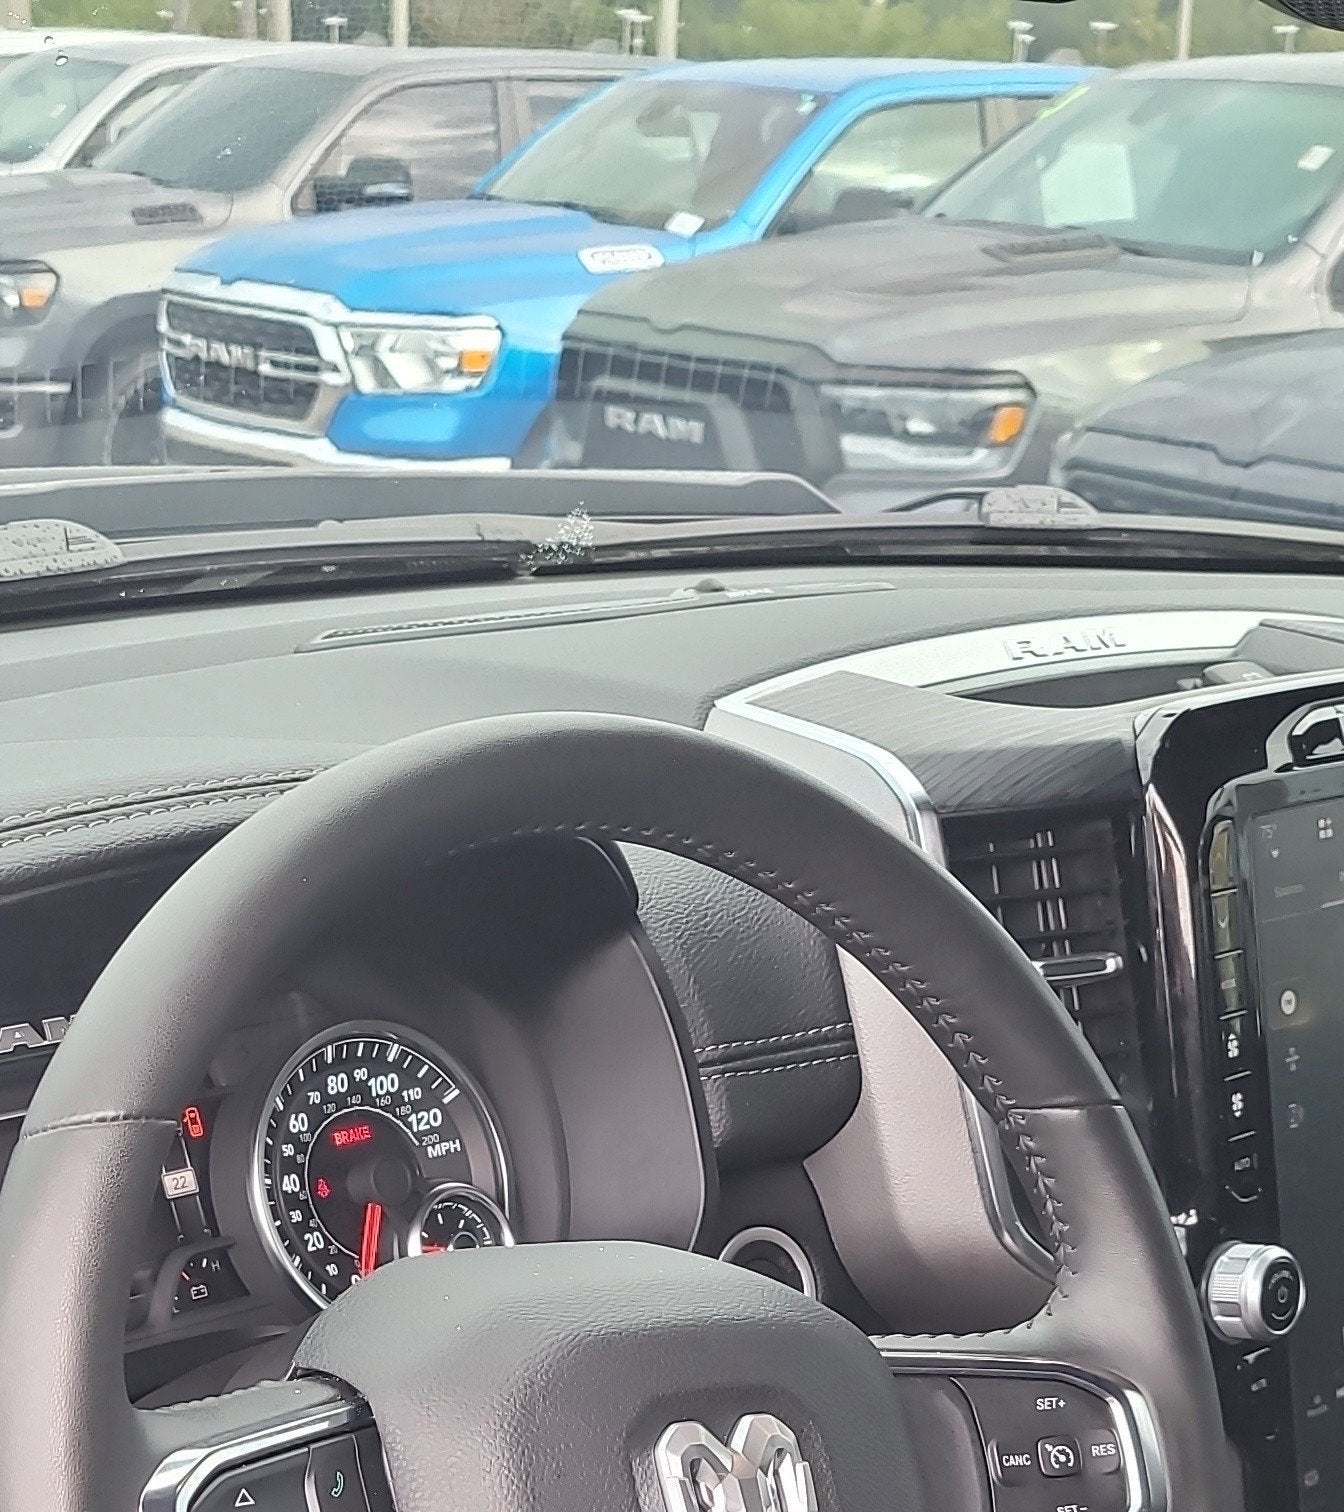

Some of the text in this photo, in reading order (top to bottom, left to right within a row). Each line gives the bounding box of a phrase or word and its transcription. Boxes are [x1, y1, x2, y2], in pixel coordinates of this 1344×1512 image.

[605, 404, 705, 444] RAM
[1004, 628, 1127, 660] RAM
[353, 1068, 368, 1082] 90
[327, 1073, 348, 1095] 80
[367, 1073, 399, 1097] 100
[307, 1091, 321, 1105] 70
[346, 1094, 362, 1106] 140
[375, 1095, 391, 1107] 160
[402, 1087, 422, 1102] 110
[289, 1113, 308, 1133] 60
[408, 1108, 443, 1132] 120
[332, 1125, 372, 1147] BRAKE
[422, 1133, 440, 1147] 200
[282, 1144, 294, 1157] 50
[426, 1138, 461, 1159] MPH
[172, 1175, 188, 1191] 22
[282, 1174, 300, 1194] 40
[289, 1210, 303, 1224] 30
[304, 1231, 325, 1251] 20
[325, 1263, 338, 1276] 10
[1036, 1397, 1066, 1411] SET+
[1091, 1444, 1116, 1457] RES
[1002, 1454, 1031, 1467] CANC
